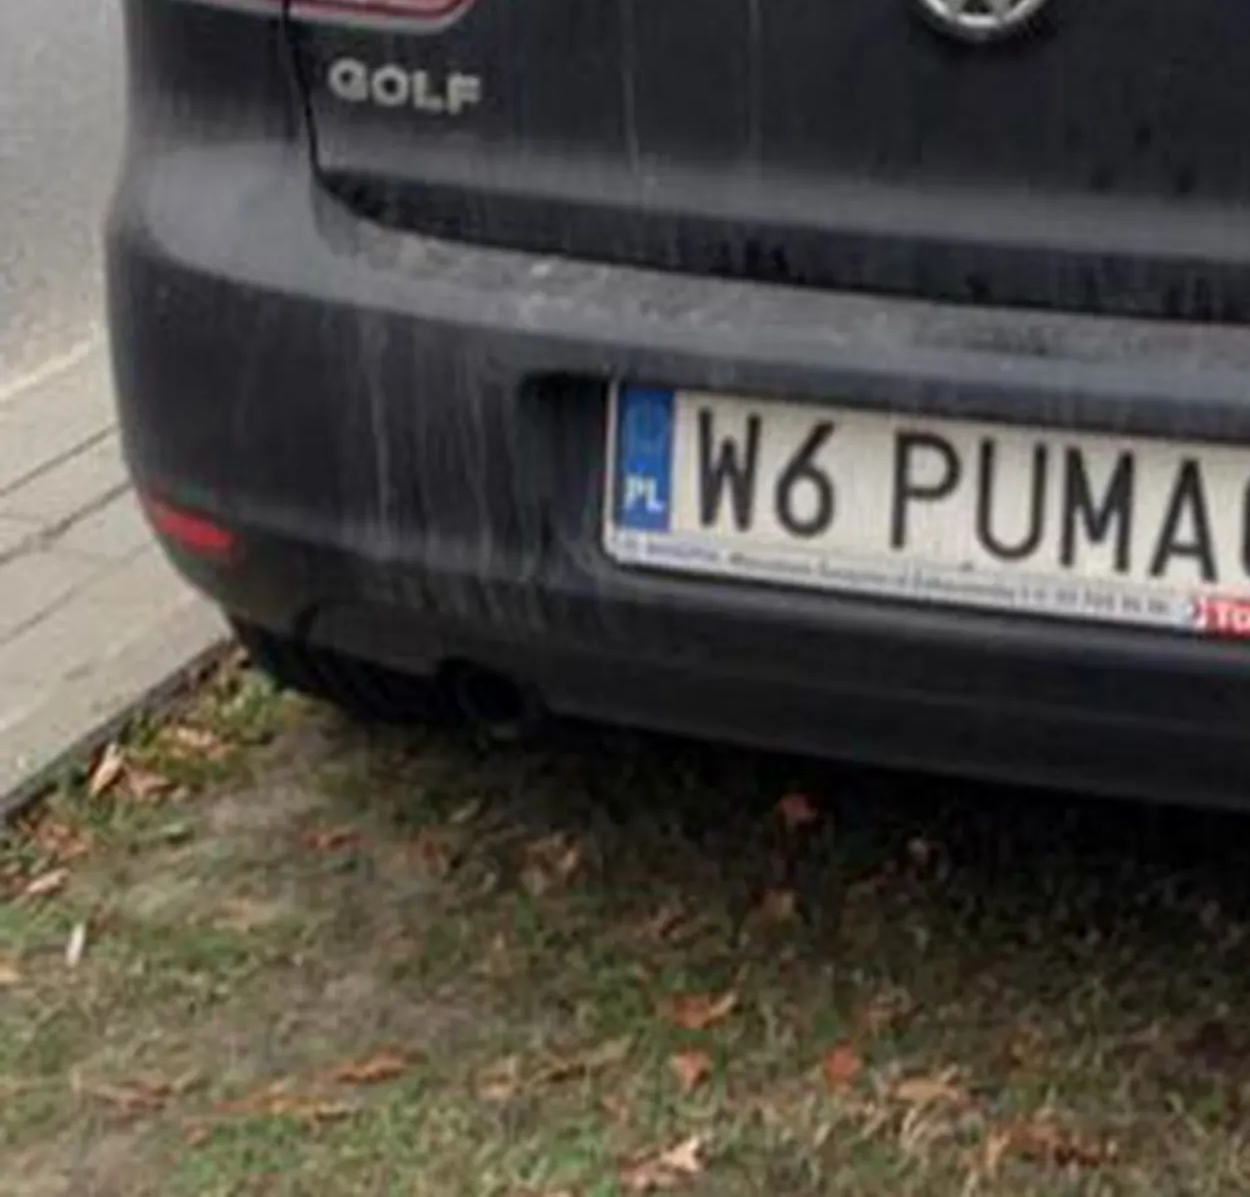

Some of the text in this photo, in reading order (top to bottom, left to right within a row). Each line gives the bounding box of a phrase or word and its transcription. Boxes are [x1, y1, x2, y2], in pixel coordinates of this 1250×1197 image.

[328, 57, 481, 117] GOLF
[623, 473, 664, 513] PL
[696, 406, 836, 540] W6
